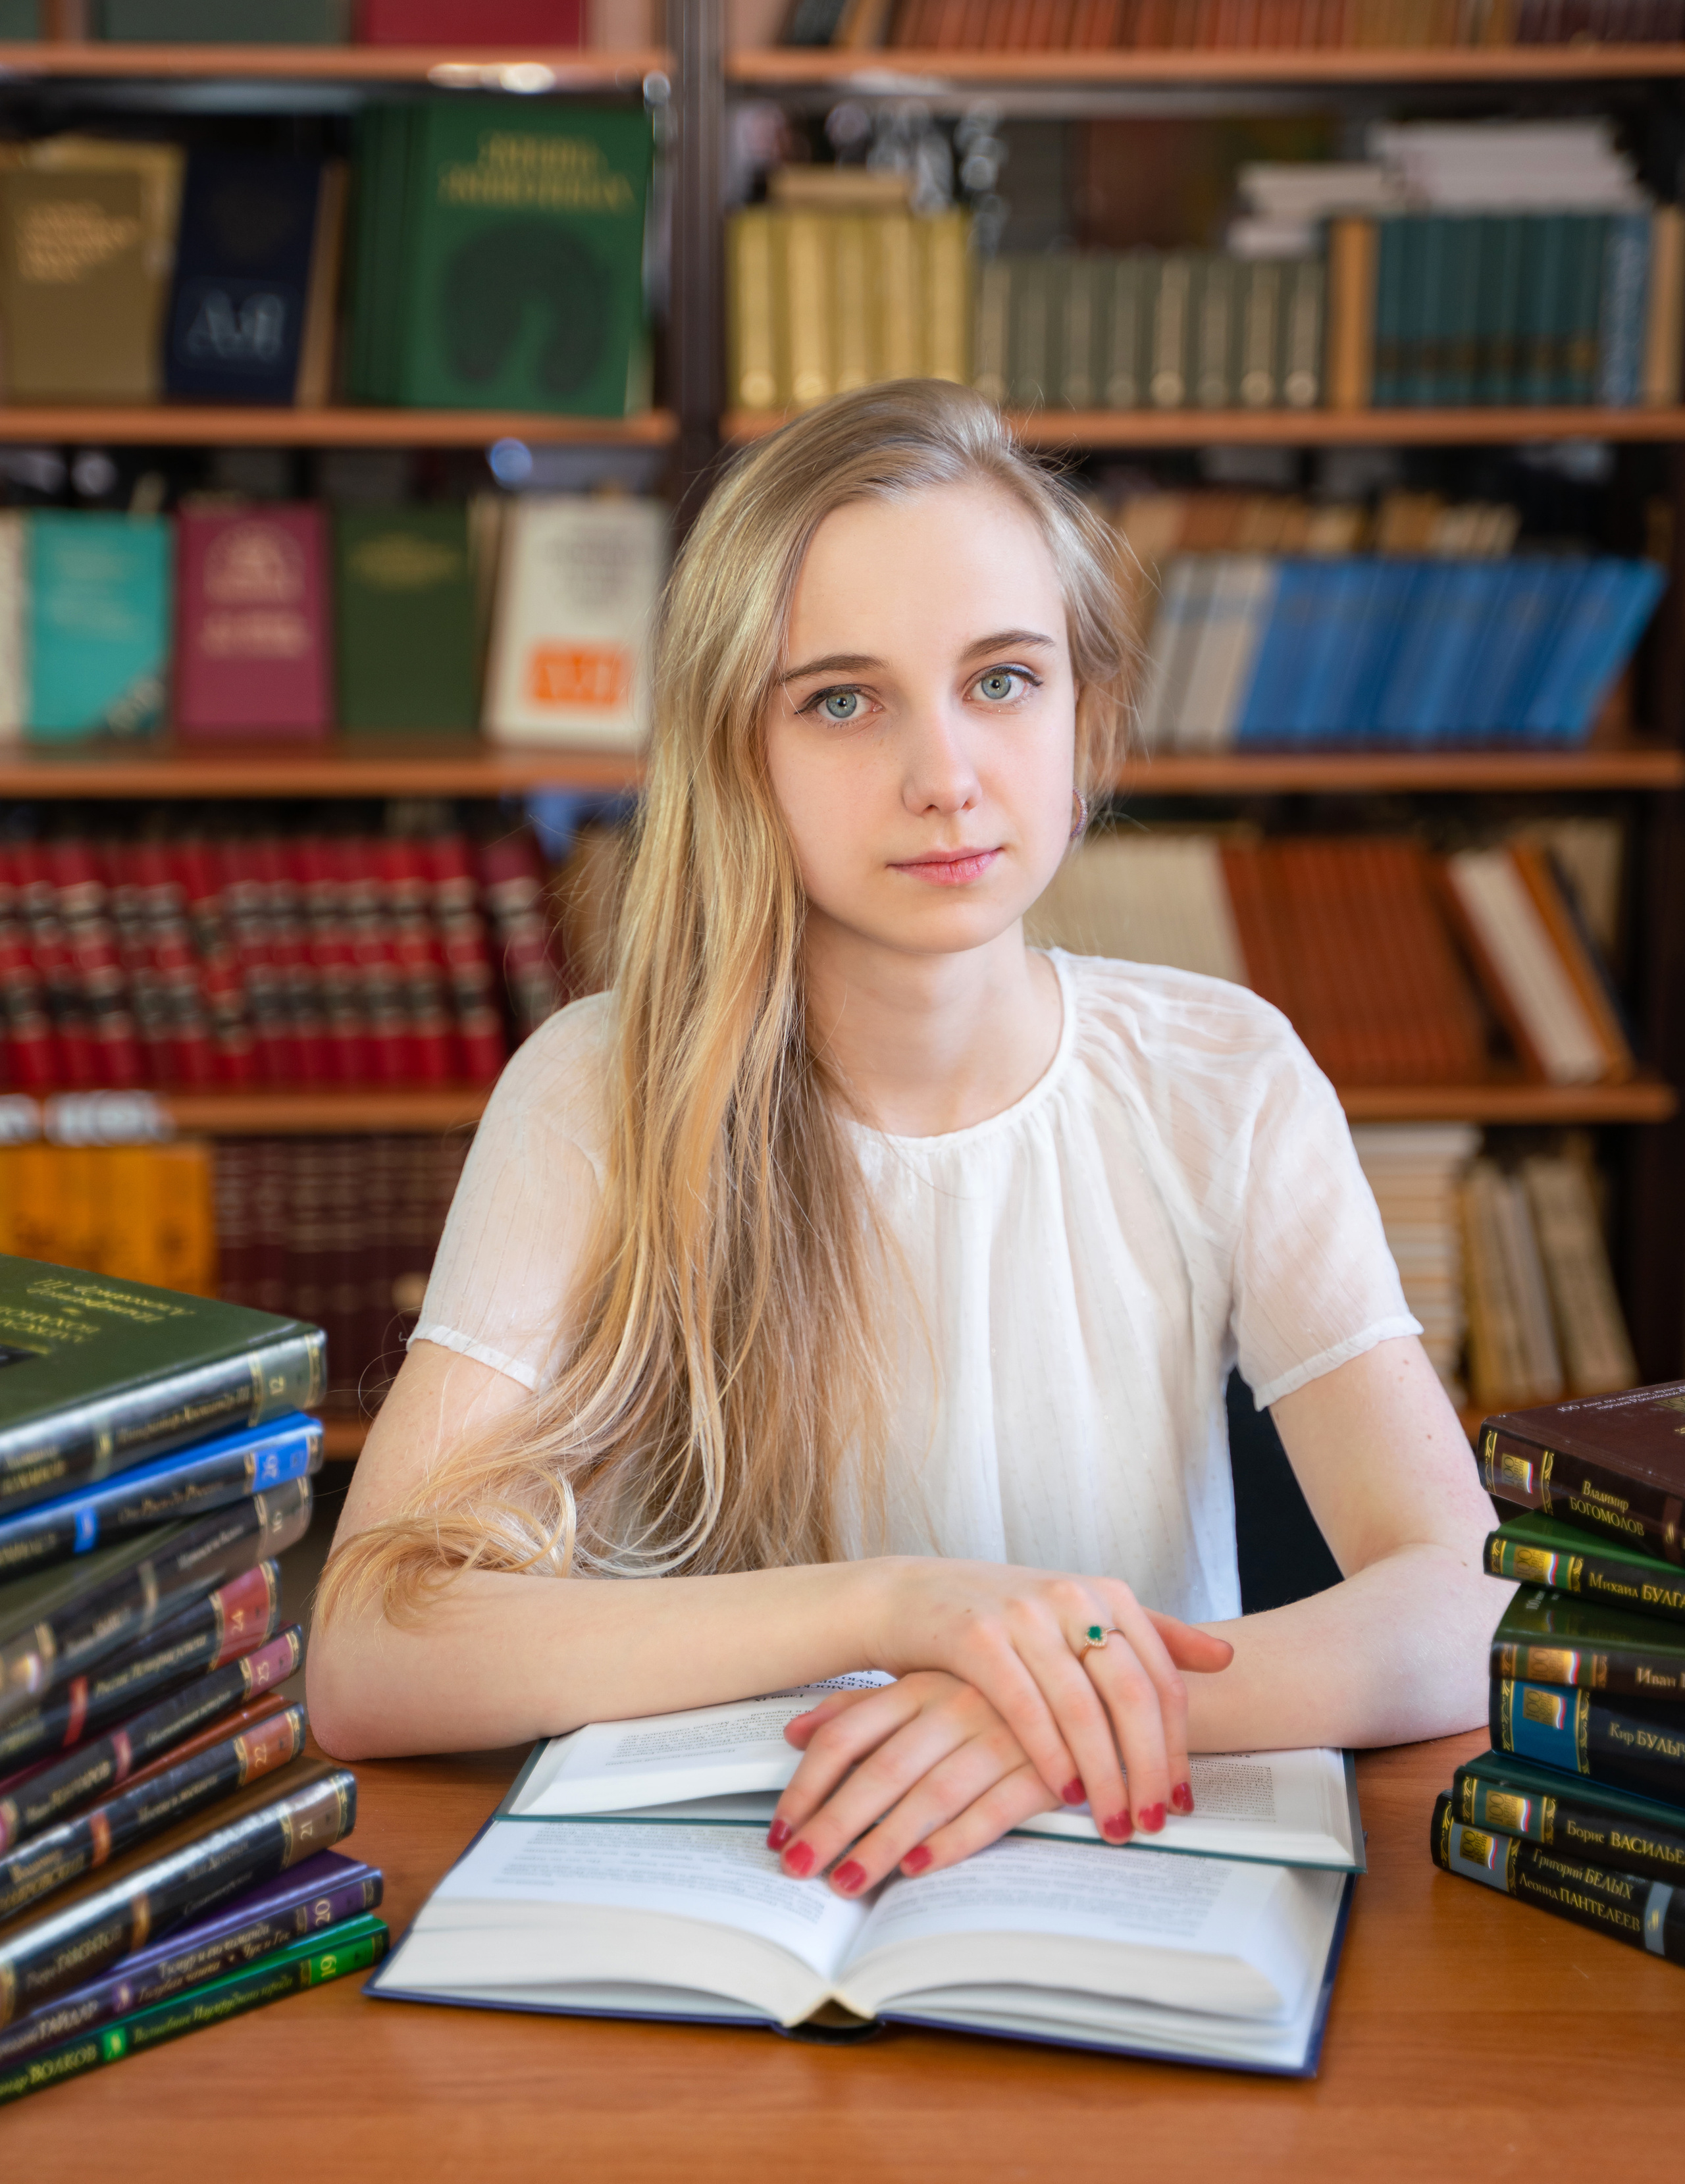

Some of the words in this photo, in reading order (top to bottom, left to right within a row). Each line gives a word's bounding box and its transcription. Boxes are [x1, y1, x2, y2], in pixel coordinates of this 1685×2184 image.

[1502, 1457, 1515, 1486] 100
[1582, 1480, 1629, 1513] Владимир
[1570, 1496, 1644, 1536] БОГОМОЛОВ
[1516, 1549, 1533, 1577] 100
[1589, 1573, 1638, 1598] Михаил
[231, 1609, 244, 1634] 24
[1636, 1667, 1676, 1687] Иван
[1525, 1690, 1540, 1719] 100
[1609, 1722, 1634, 1744] Кир
[254, 1744, 267, 1768] 22
[1489, 1794, 1504, 1823] 100
[300, 1821, 314, 1840] 21
[1463, 1830, 1476, 1858] 100
[1567, 1819, 1605, 1844] Борис
[1611, 1831, 1685, 1864] ВАСИЛЬЕ
[1532, 1848, 1583, 1881] Григорий
[1585, 1867, 1634, 1900] БЕЛЫХ
[314, 1898, 332, 1924] 20
[1519, 1873, 1559, 1900] Леонид
[1560, 1887, 1640, 1932] ПАНТЕЛЕЕВ
[159, 1952, 195, 1979] Тимур
[320, 1954, 336, 1977] 19
